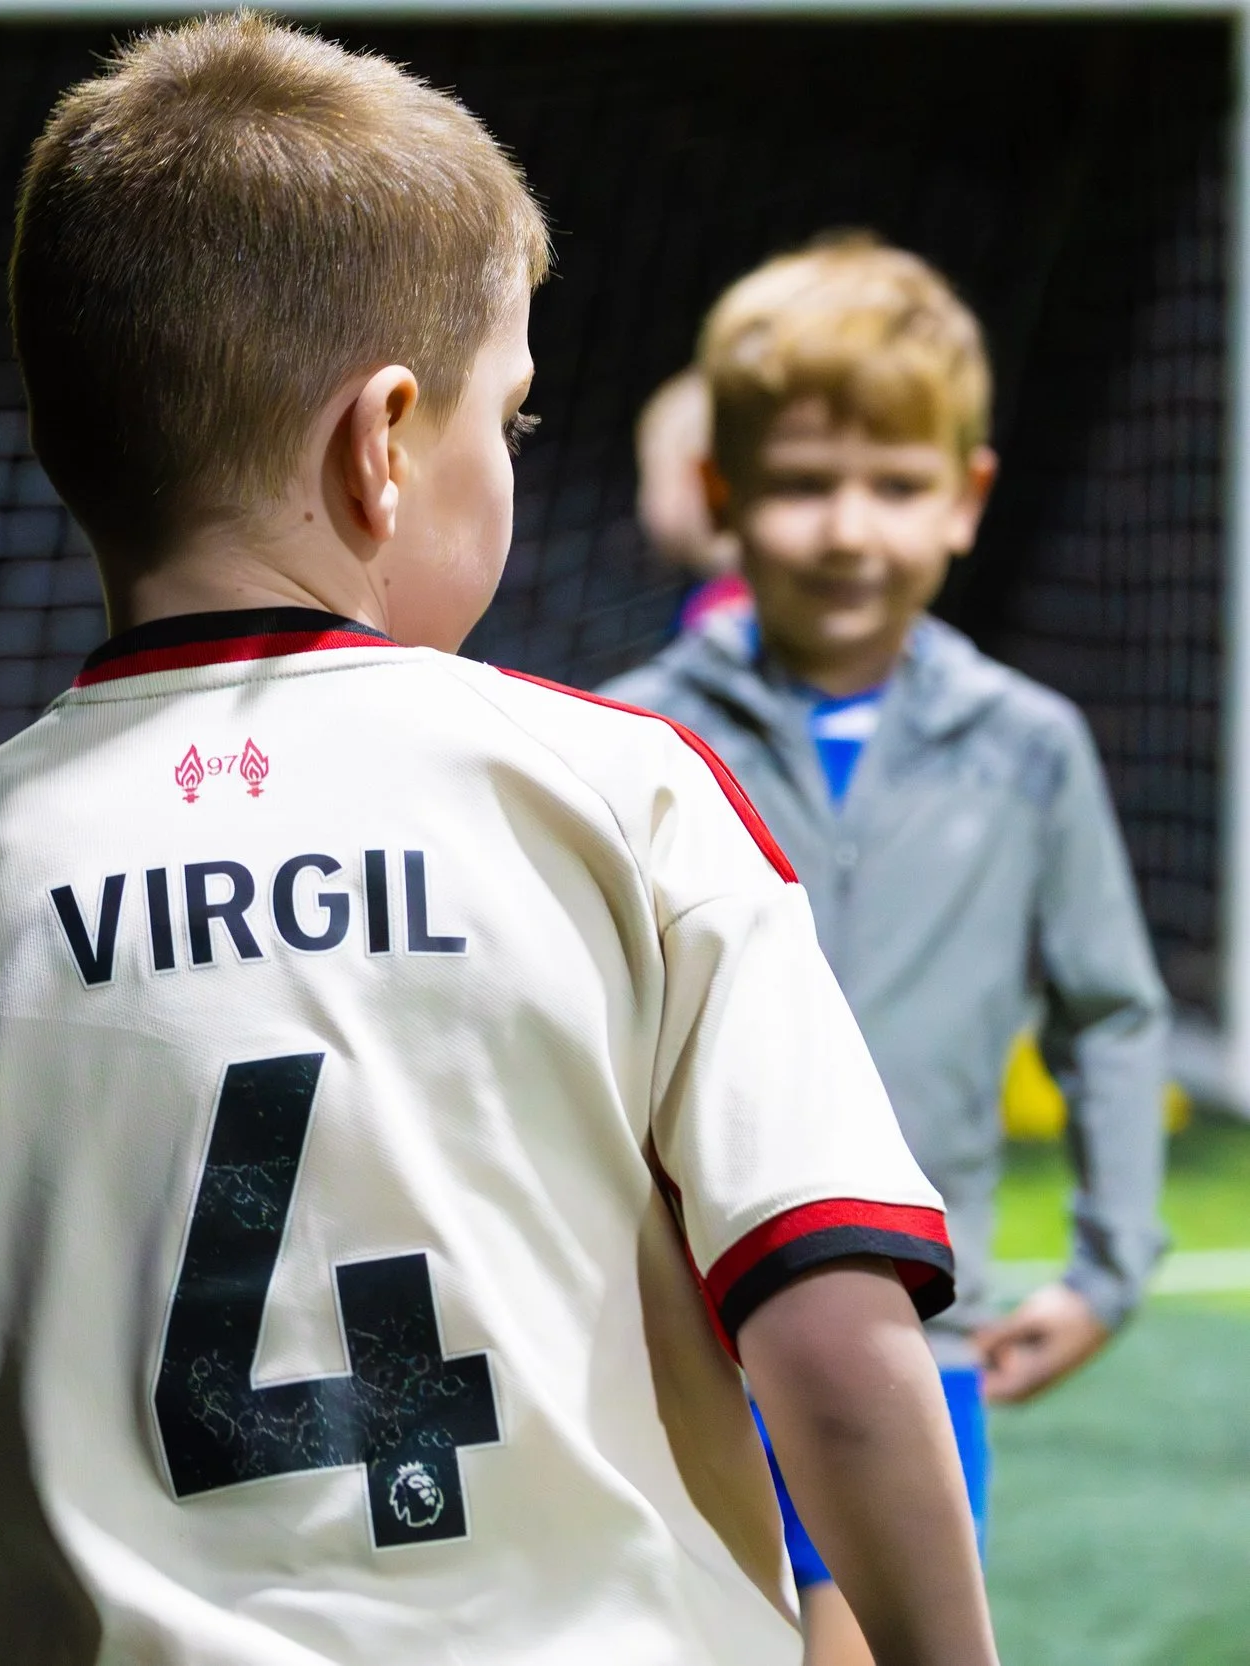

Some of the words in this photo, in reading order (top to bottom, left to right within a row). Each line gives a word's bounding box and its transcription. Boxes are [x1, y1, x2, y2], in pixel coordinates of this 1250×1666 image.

[206, 754, 239, 776] 97
[49, 848, 468, 988] VIRGIL
[152, 1051, 504, 1550] 4
